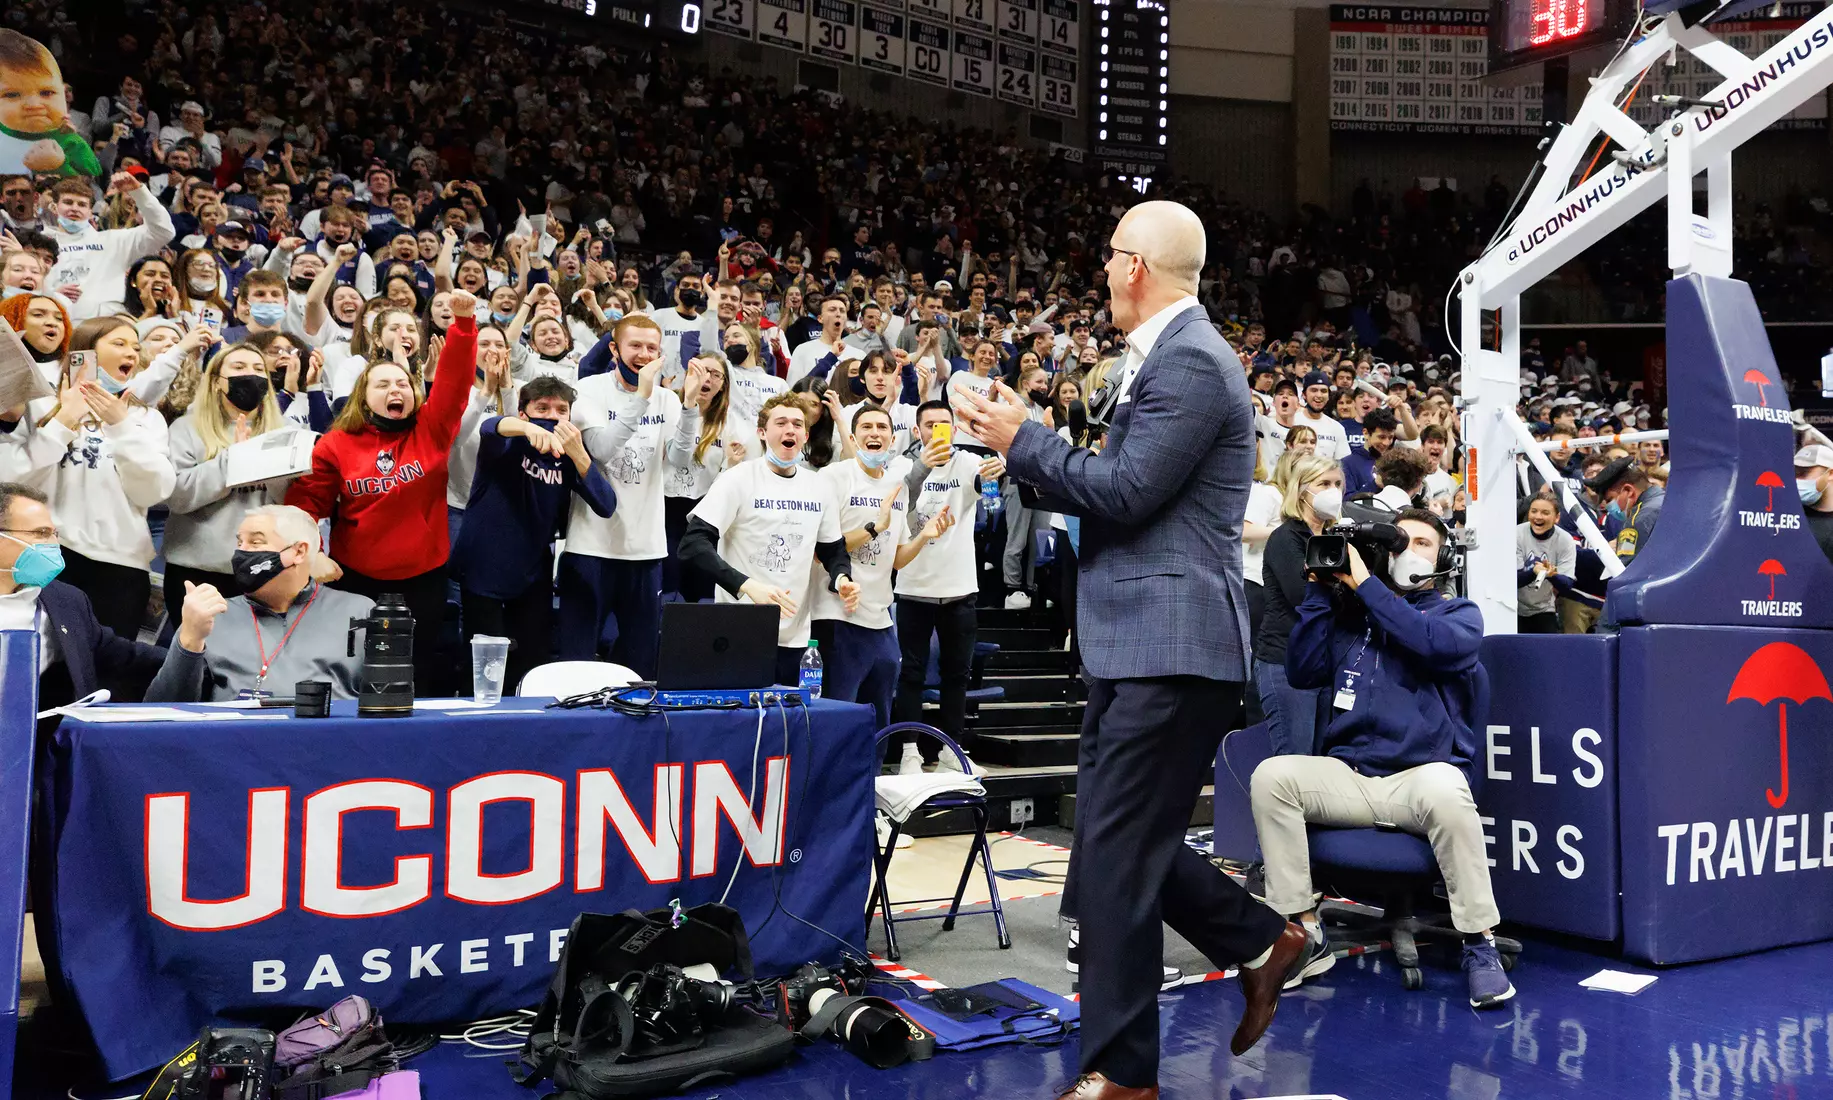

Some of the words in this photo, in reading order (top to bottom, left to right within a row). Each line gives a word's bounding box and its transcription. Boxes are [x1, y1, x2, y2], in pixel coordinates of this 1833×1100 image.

[681, 3, 700, 34] 0
[774, 12, 788, 37] 4
[1008, 7, 1026, 32] 31
[1343, 8, 1392, 20] NCAA
[819, 21, 846, 50] 30
[1051, 19, 1067, 43] 14
[1439, 25, 1489, 35] SIXTEE
[875, 36, 888, 60] 3
[915, 46, 940, 73] CD
[964, 58, 982, 83] 15
[1002, 69, 1030, 95] 24
[1045, 80, 1072, 105] 33
[1525, 108, 1542, 121] 202
[1117, 132, 1142, 142] STEALS
[1331, 121, 1412, 132] CONNECTICUT
[1416, 123, 1470, 134] WOMEN'S
[1474, 125, 1543, 136] BASKETBAL
[1126, 163, 1137, 173] OF
[1139, 164, 1156, 175] DAY
[754, 498, 774, 510] BEAT
[777, 500, 803, 512] SETON
[850, 496, 868, 507] BEAT
[1739, 511, 1800, 530] TRAVEERS
[1741, 600, 1802, 618] TRAVELERS
[144, 756, 791, 932] UCONN
